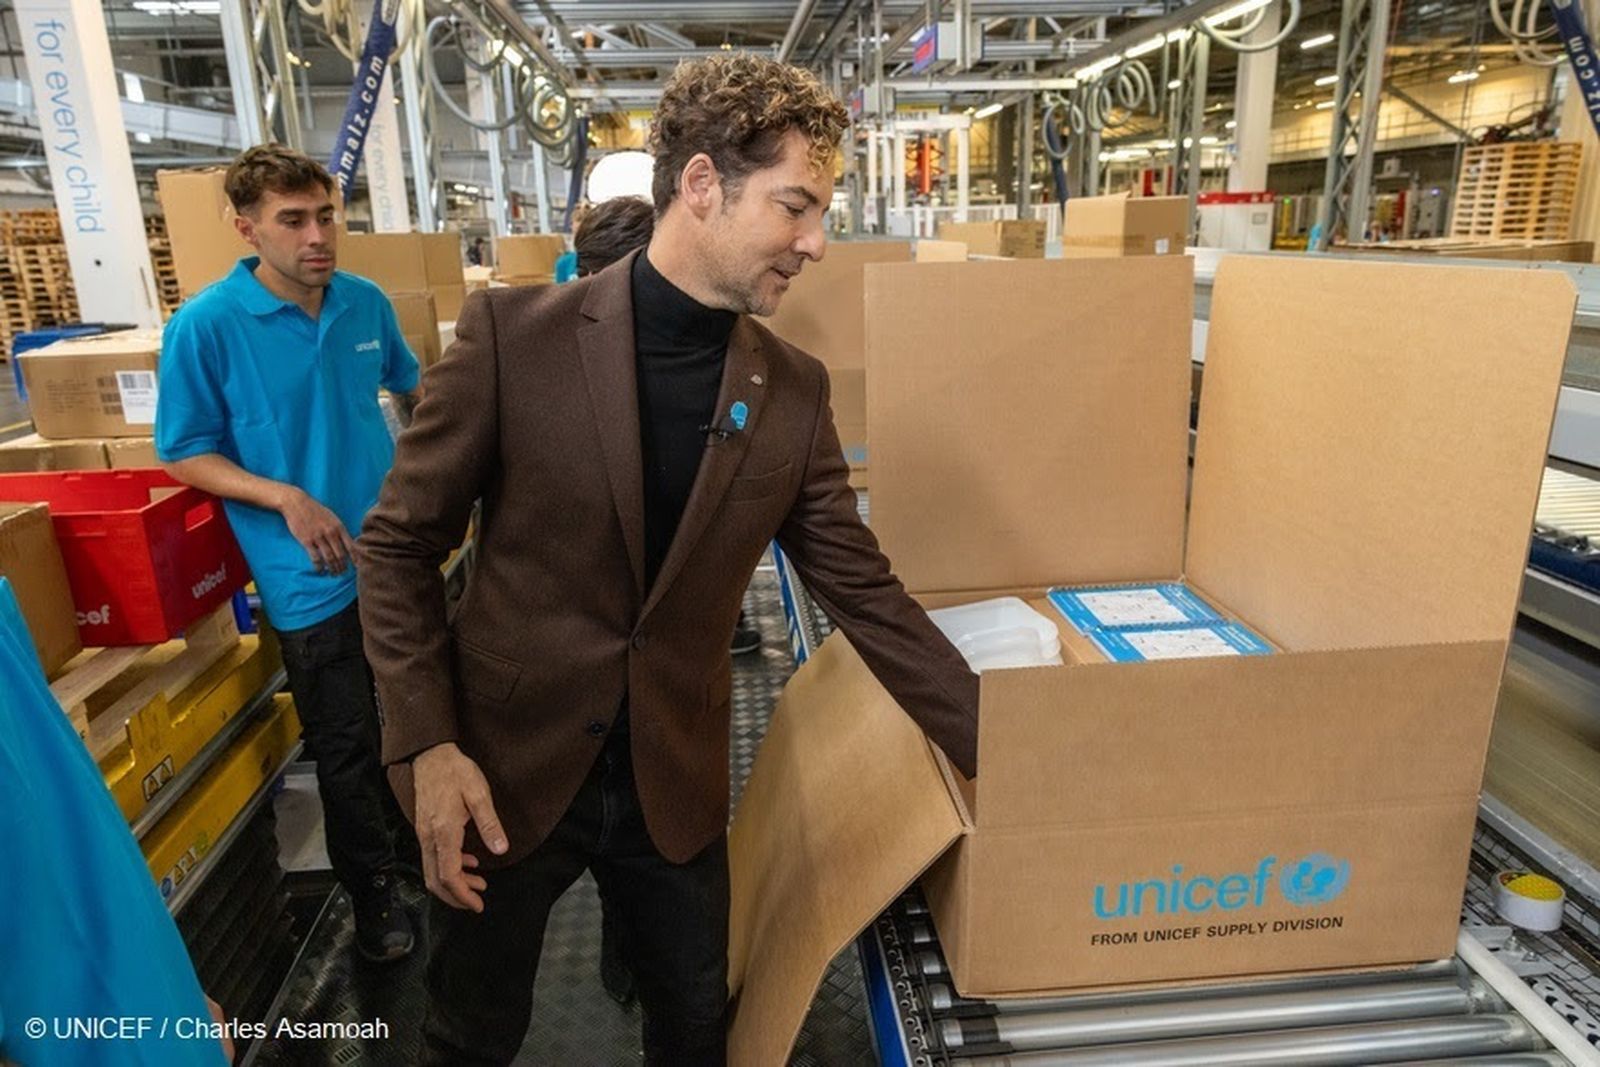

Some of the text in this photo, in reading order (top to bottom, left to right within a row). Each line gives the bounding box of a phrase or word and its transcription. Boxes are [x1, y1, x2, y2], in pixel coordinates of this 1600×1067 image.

[34, 20, 106, 233] for every child
[192, 562, 227, 599] unicef
[1093, 855, 1279, 921] unicef
[1091, 916, 1344, 946] FROM UNICEF SUPPLY DIVISION
